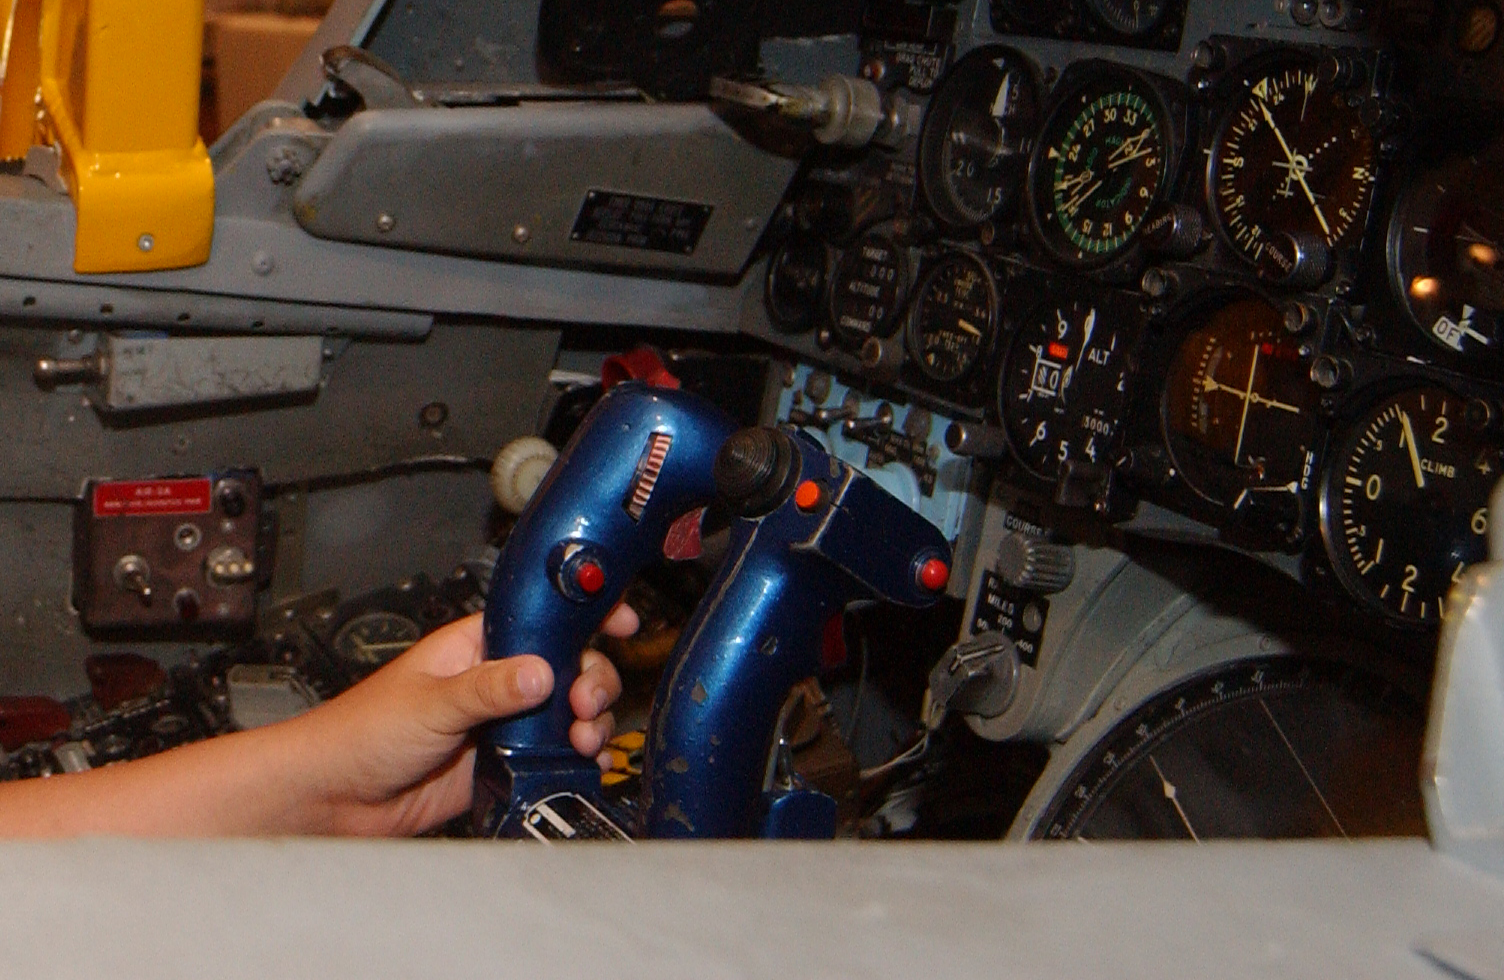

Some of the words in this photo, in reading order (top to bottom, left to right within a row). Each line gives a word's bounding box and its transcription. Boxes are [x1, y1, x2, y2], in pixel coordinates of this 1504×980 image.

[1102, 106, 1118, 125] 30
[1122, 107, 1139, 127] 33
[1081, 117, 1096, 139] 27
[1067, 142, 1082, 164] 24
[1057, 319, 1069, 341] 9
[1087, 345, 1112, 366] ALT
[1035, 420, 1047, 441] 6
[1431, 416, 1448, 445] 2
[1057, 439, 1070, 462] 5
[1084, 436, 1097, 464] 4
[1420, 456, 1457, 479] CLIMB
[1365, 474, 1382, 501] 0
[1470, 506, 1490, 536] 6
[1400, 564, 1419, 594] 2
